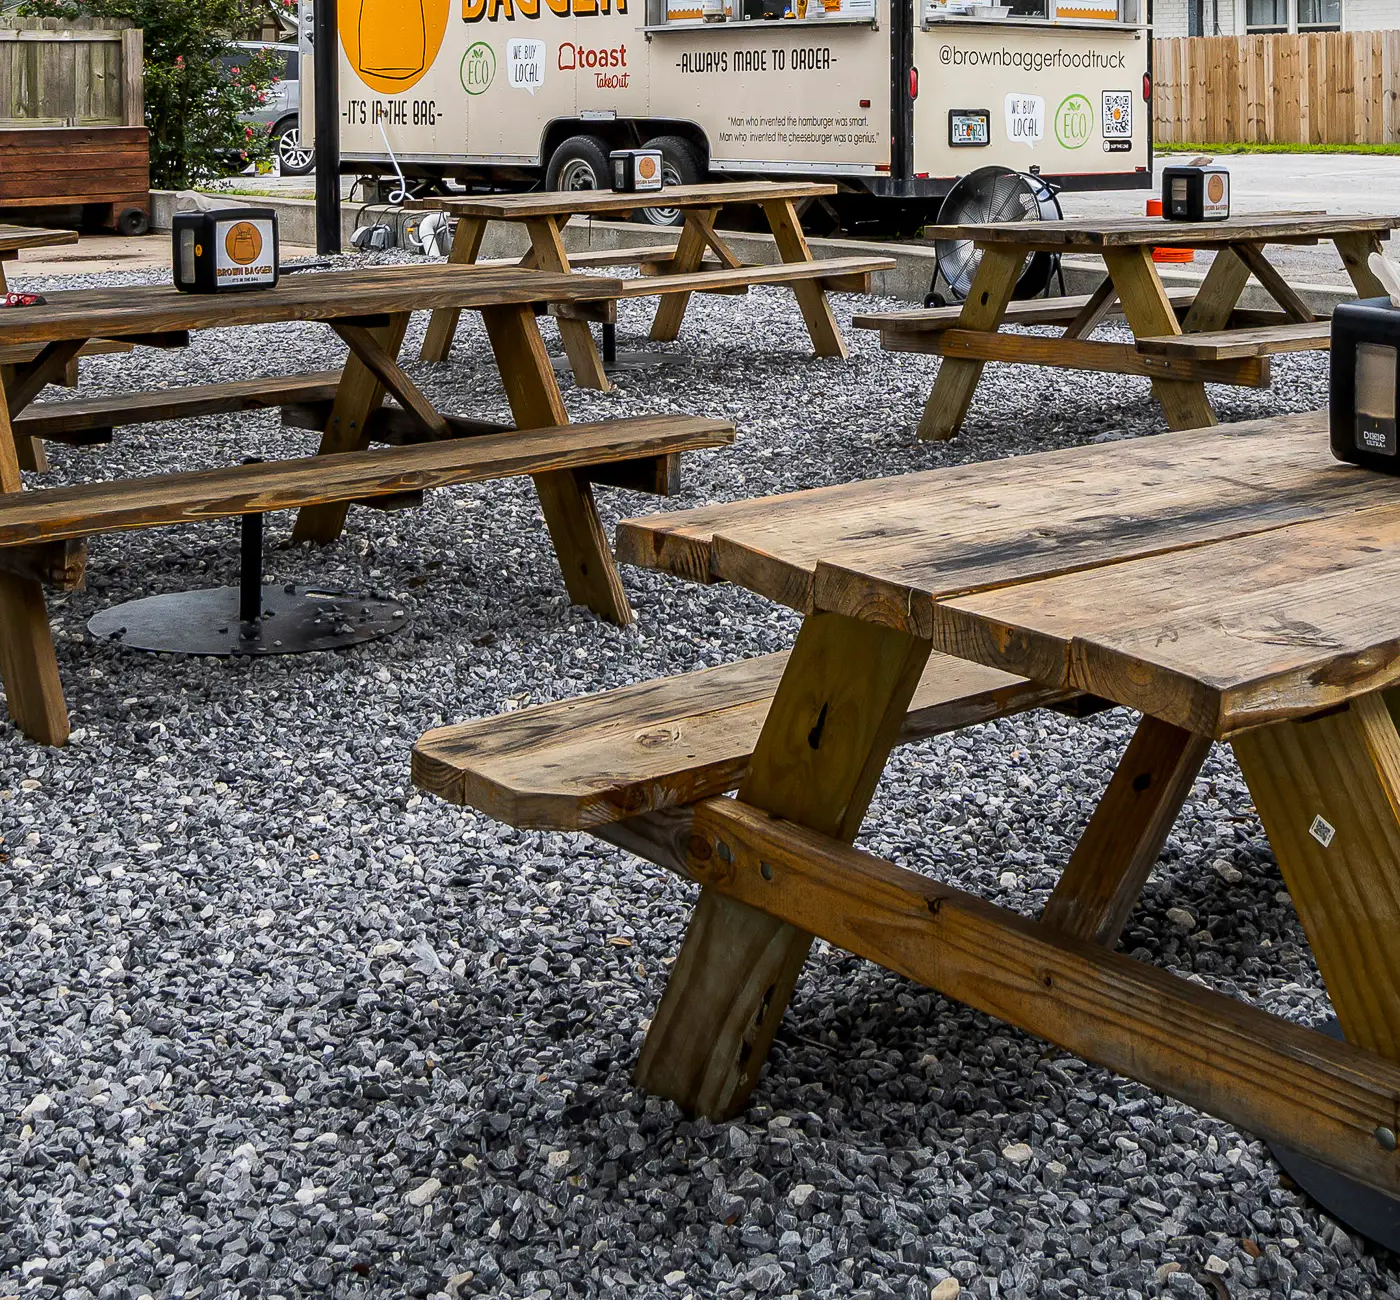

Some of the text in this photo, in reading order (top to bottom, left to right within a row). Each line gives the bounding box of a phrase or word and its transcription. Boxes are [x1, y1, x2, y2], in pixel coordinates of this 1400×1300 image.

[513, 45, 537, 60] WE BUY
[577, 44, 627, 68] toast
[733, 50, 767, 72] MADE
[771, 49, 785, 71] TO
[939, 45, 1126, 71] @brownbaggerfoodtruck
[468, 60, 489, 85] ECO
[515, 63, 539, 82] LOCAL
[594, 72, 630, 88] TakeOut
[388, 100, 407, 125] THE
[1011, 100, 1036, 114] WE BUY
[745, 116, 758, 127] who
[759, 116, 786, 127] invented
[787, 116, 797, 127] the
[798, 116, 834, 129] hamburger
[835, 118, 848, 127] was
[1013, 118, 1039, 136] LOCAL
[1063, 113, 1087, 138] ECO
[719, 132, 733, 142] Man
[734, 132, 747, 142] who
[749, 132, 776, 143] invented
[777, 132, 788, 142] the
[788, 132, 834, 145] cheeseburger
[834, 134, 847, 143] was
